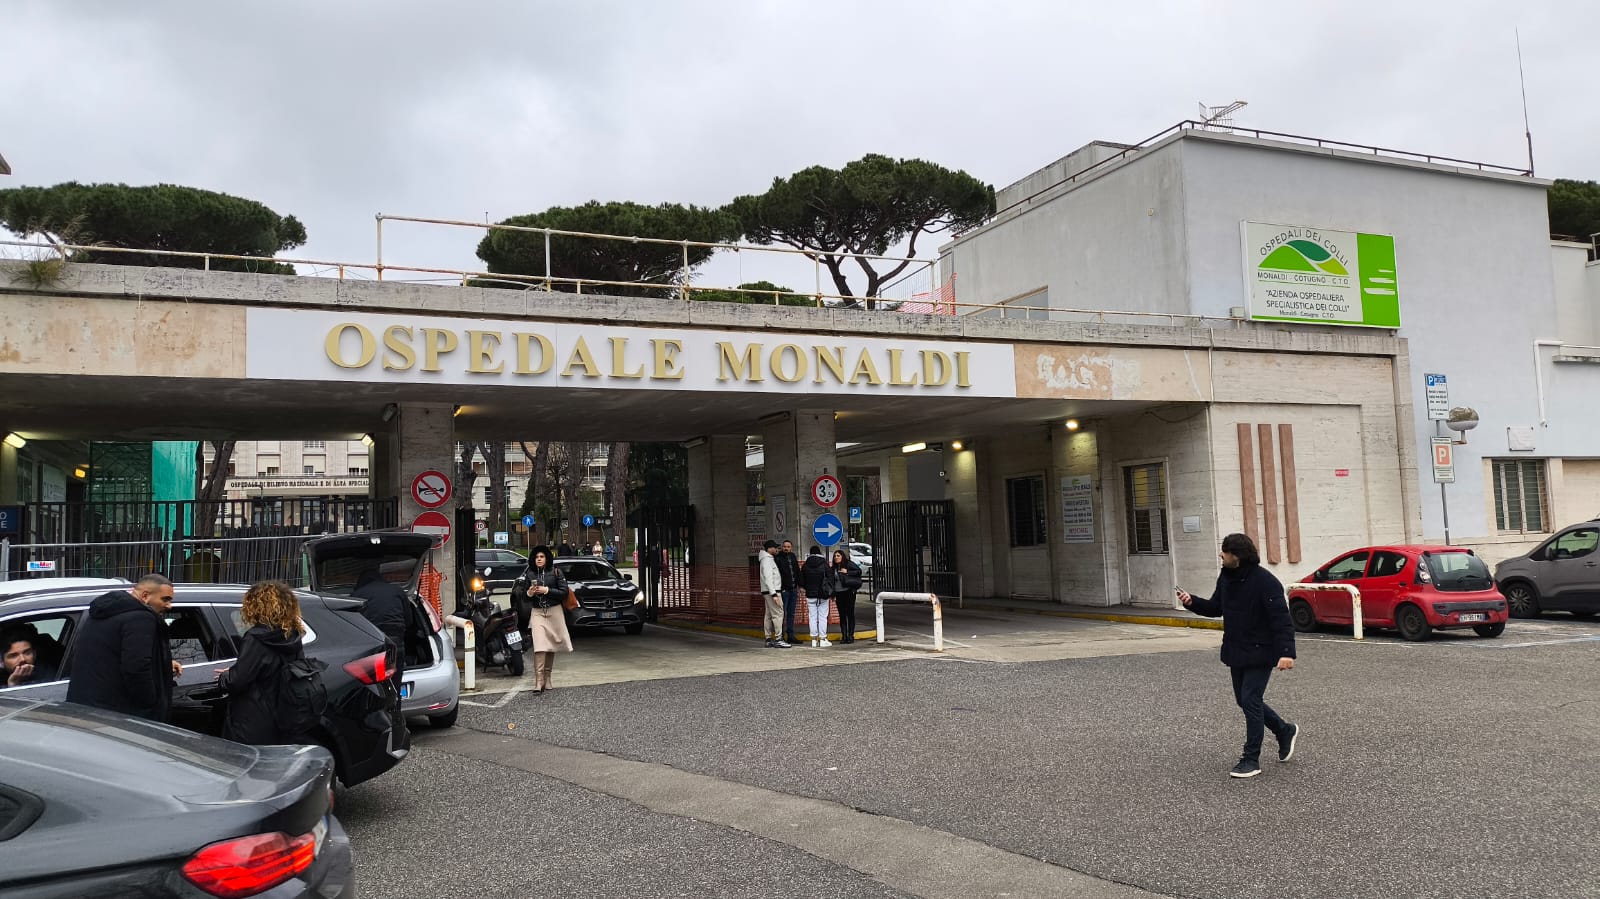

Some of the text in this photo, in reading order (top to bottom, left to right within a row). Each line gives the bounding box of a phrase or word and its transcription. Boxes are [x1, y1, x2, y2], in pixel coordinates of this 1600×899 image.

[1260, 229, 1349, 266] OSPEDALI DEI COLLI
[1257, 272, 1288, 281] MONALDI
[1294, 274, 1326, 284] COTUGNO
[1265, 289, 1345, 302] "AZIENDA OSPEDALIERA
[1266, 300, 1350, 312] SPECIALISTICA DEI COLLI"
[325, 321, 971, 388] OSPEDALE MONALDI
[1428, 375, 1434, 385] P
[1438, 447, 1447, 463] P
[819, 484, 826, 498] 3
[852, 508, 859, 517] P
